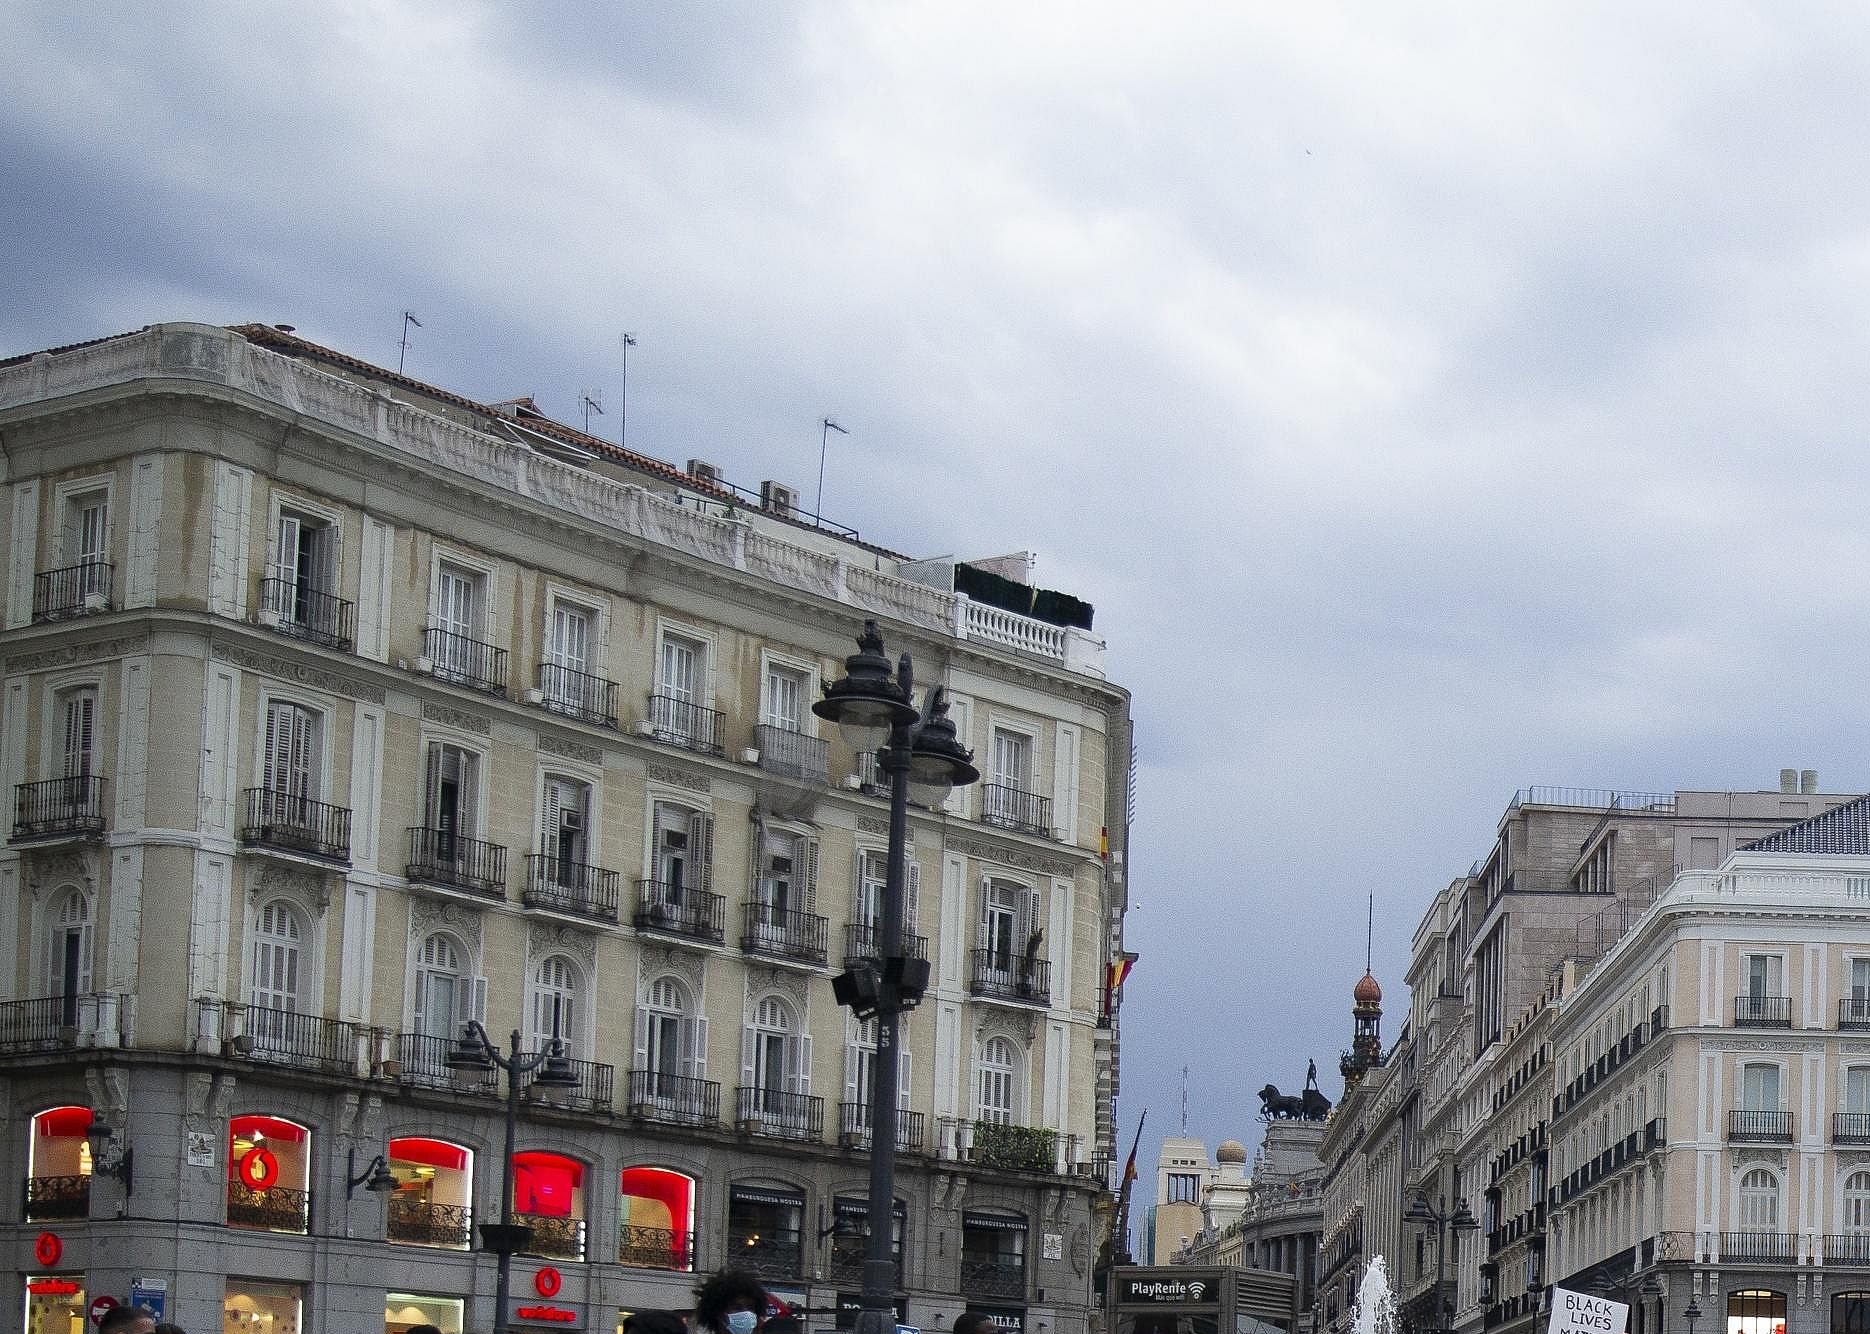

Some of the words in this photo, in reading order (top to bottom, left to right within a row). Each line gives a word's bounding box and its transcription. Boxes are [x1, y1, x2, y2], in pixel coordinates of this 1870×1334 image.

[1131, 1282, 1187, 1297] PlayRenfe
[1566, 1294, 1613, 1316] BLACK
[1570, 1311, 1612, 1331] LIVES
